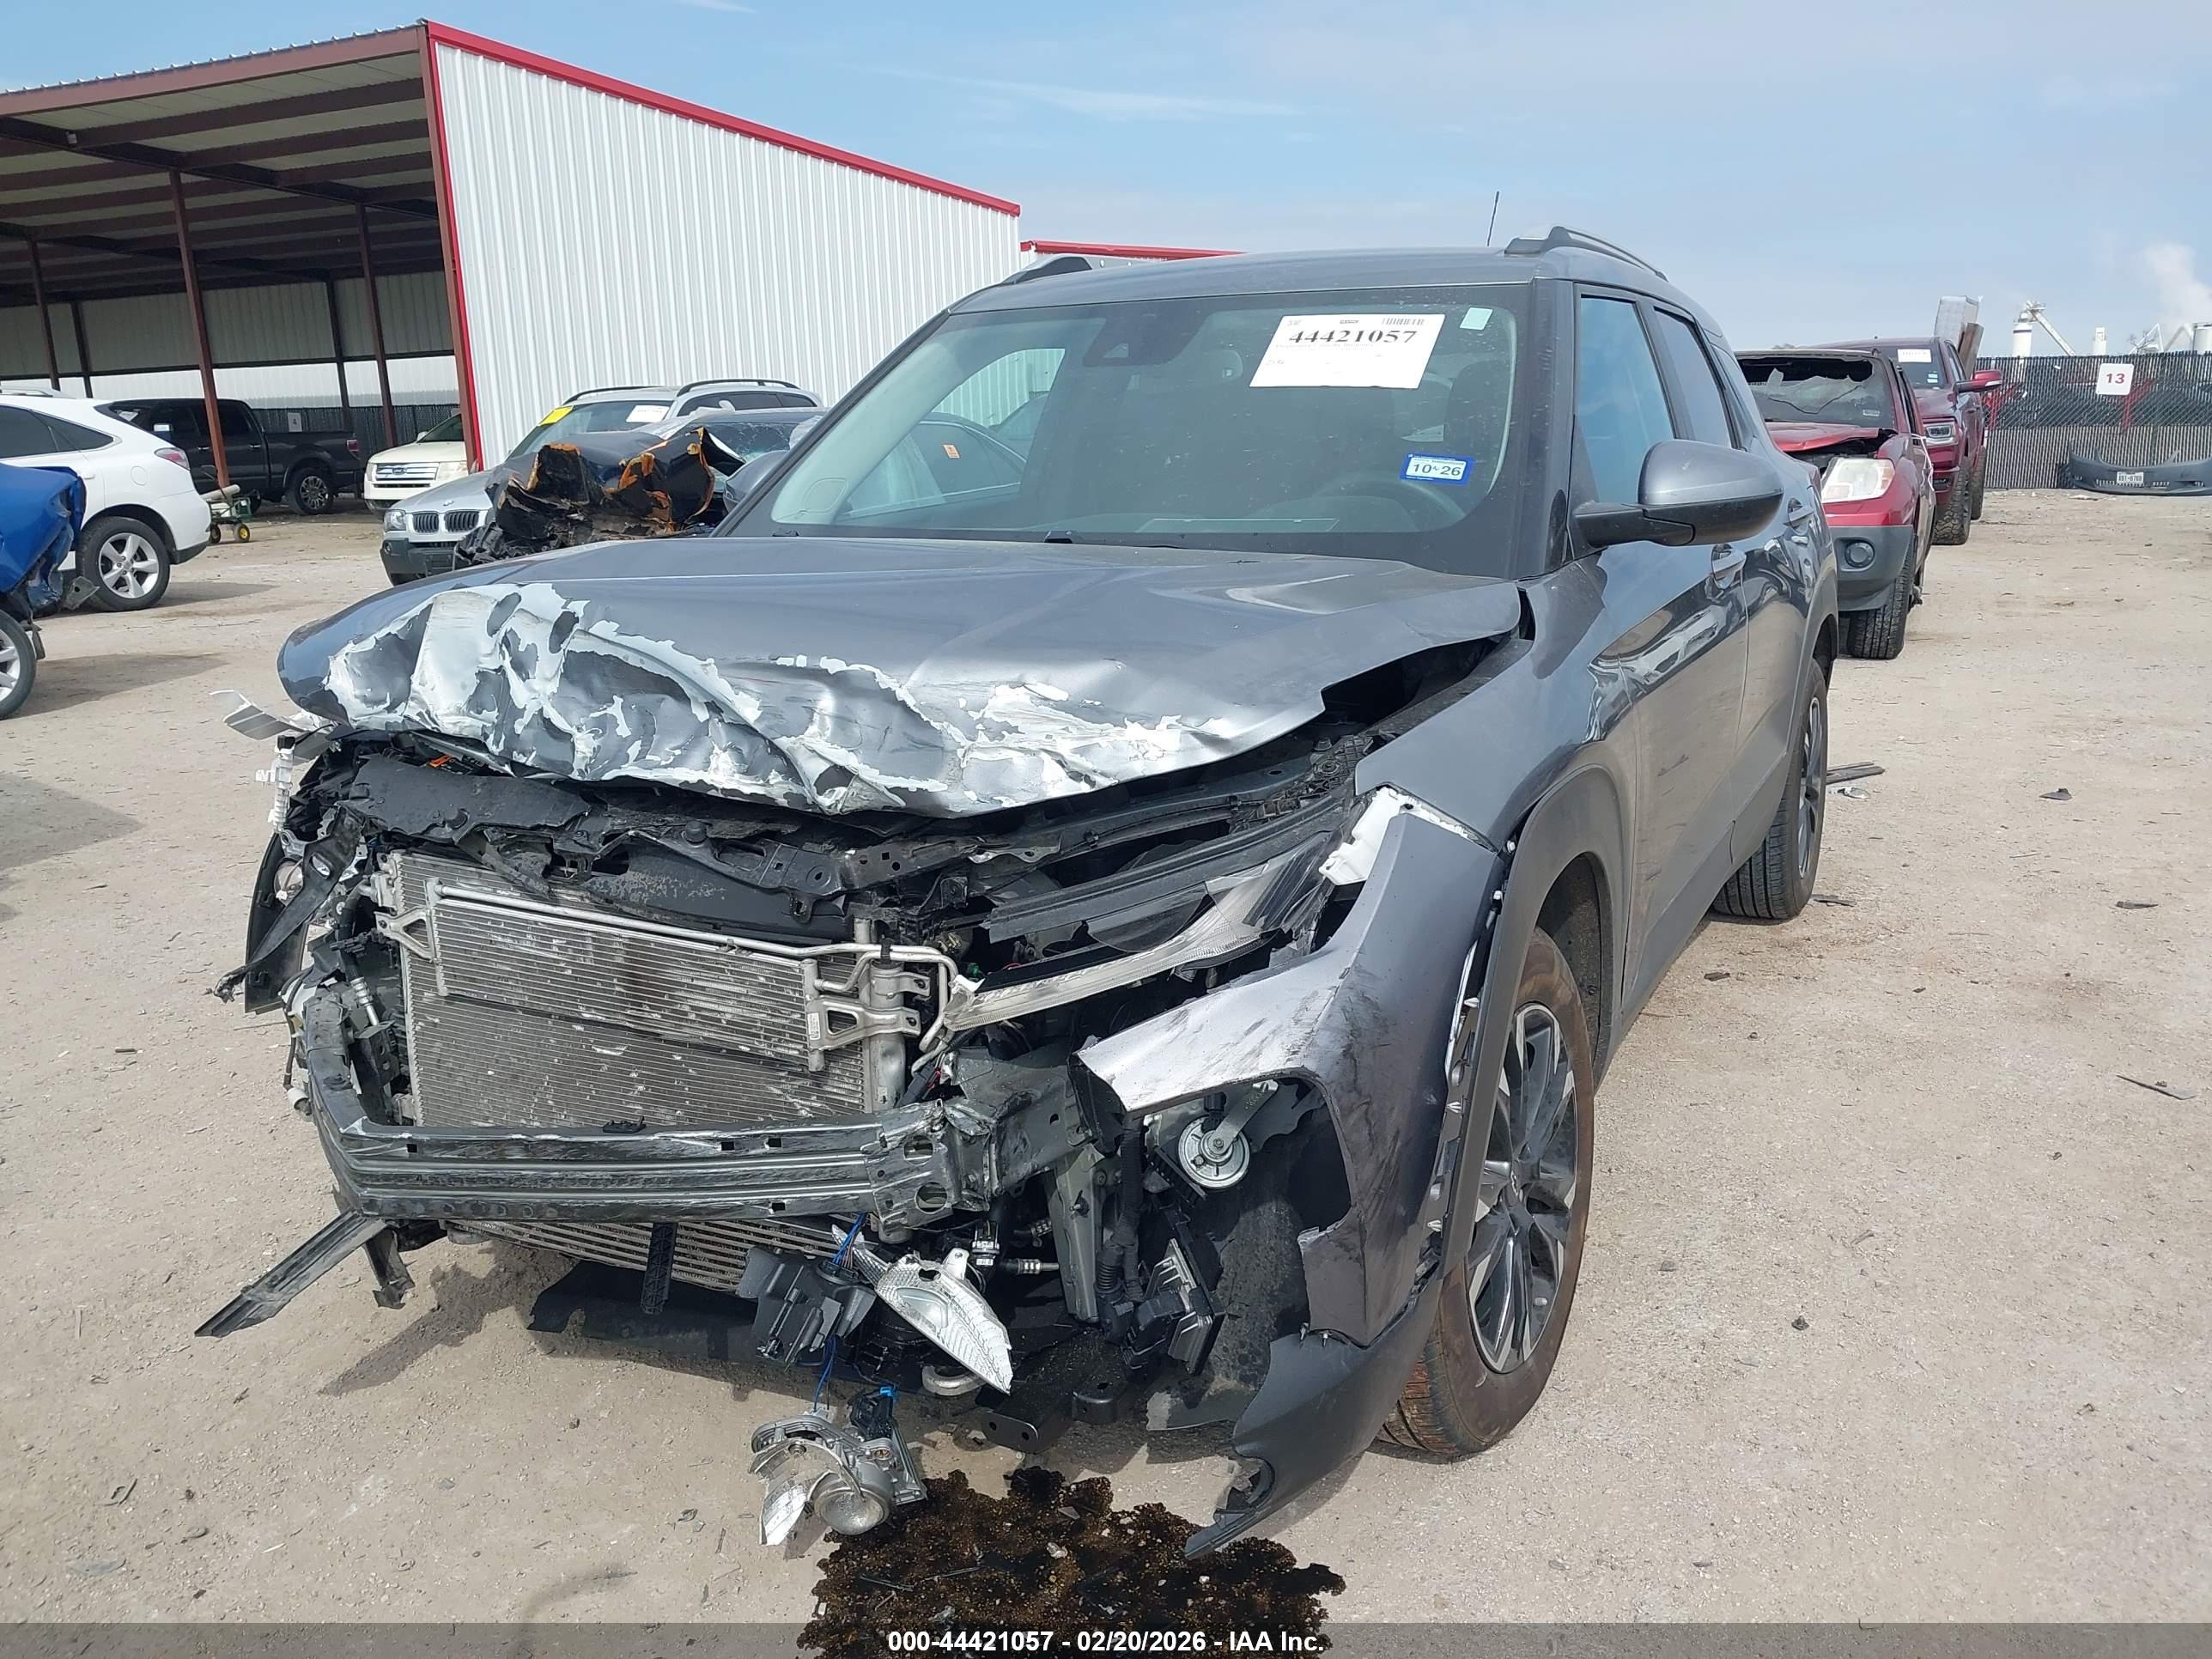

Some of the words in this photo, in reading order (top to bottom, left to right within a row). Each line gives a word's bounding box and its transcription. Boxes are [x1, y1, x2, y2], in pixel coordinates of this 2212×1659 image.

[1288, 330, 1419, 343] 44421057
[2106, 373, 2125, 385] 13
[1413, 464, 1432, 474] 10
[1440, 465, 1462, 477] 26
